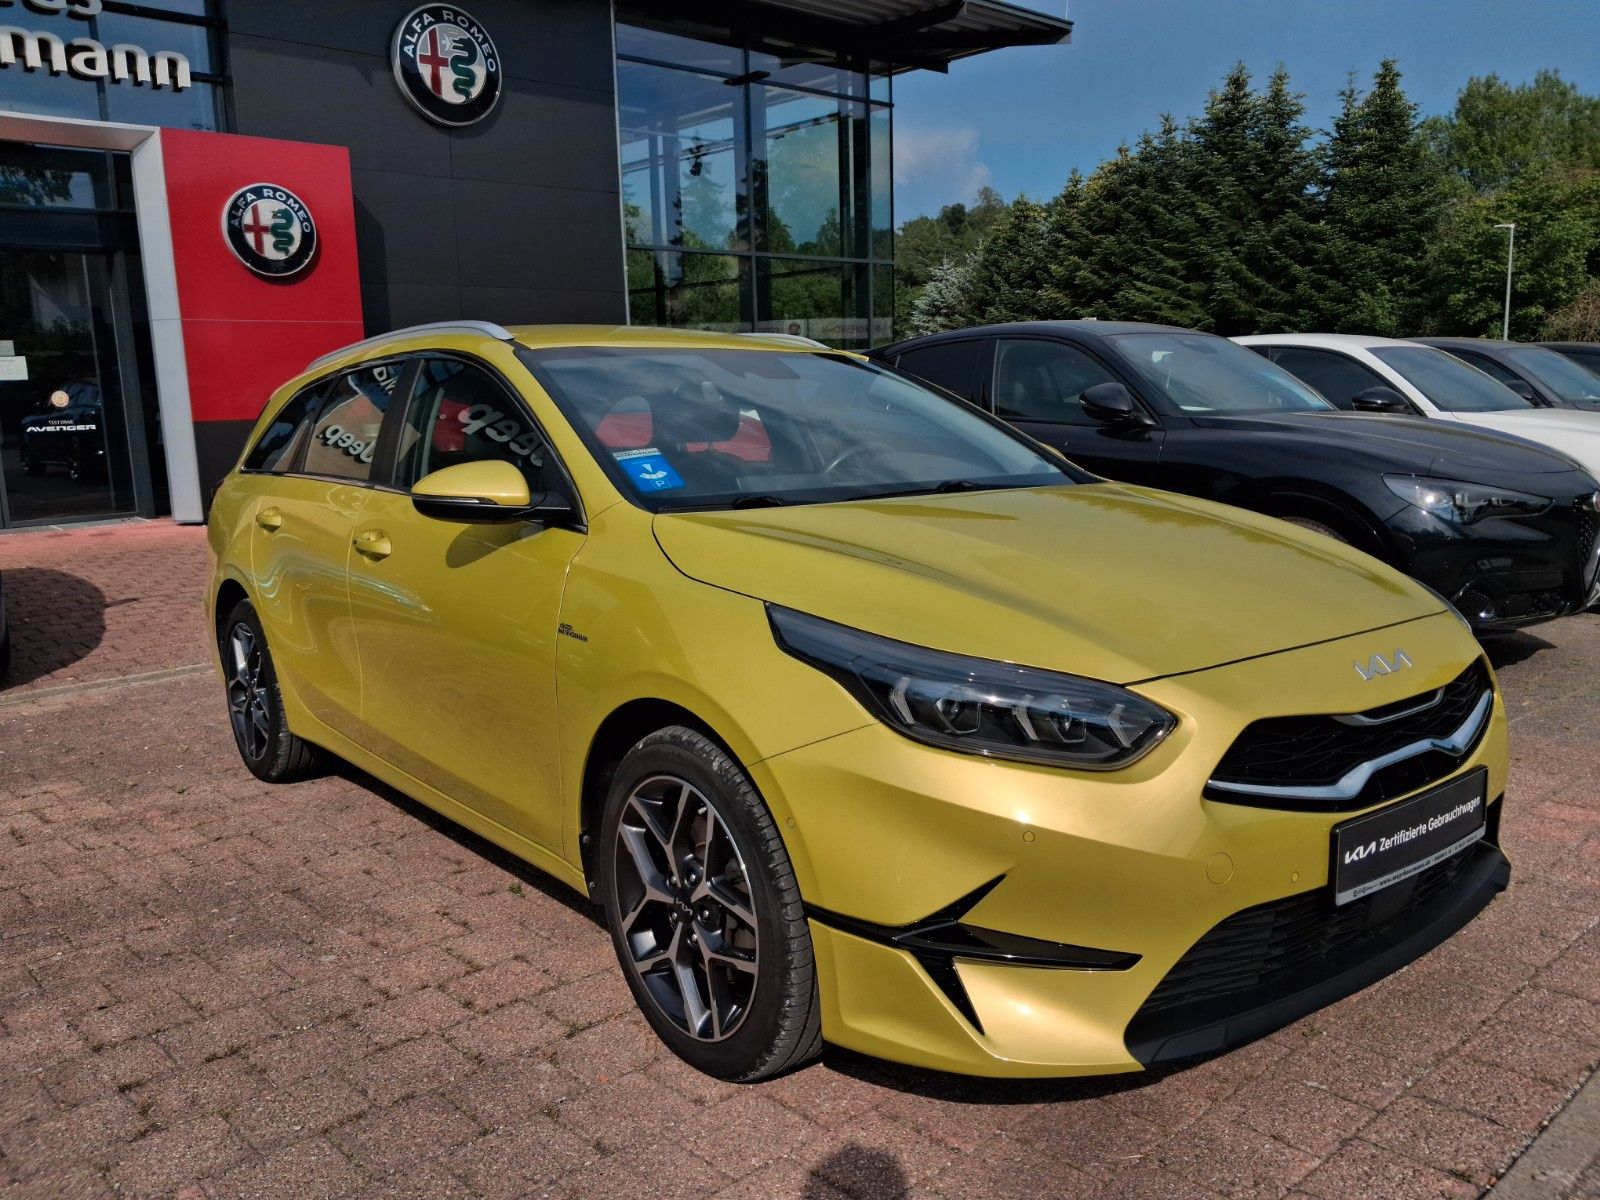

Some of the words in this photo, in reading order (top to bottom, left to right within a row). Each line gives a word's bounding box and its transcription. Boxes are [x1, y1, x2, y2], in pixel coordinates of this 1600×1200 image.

[403, 13, 435, 58] ALFA
[442, 10, 496, 72] ROMEO
[230, 192, 257, 228] ALFA
[263, 188, 311, 233] ROMEO
[26, 424, 96, 433] AVENGER
[1354, 648, 1412, 681] KIA
[1344, 841, 1377, 865] KIA
[1379, 823, 1427, 852] Zertifizierte
[1428, 796, 1481, 832] Gebrauchtwagen
